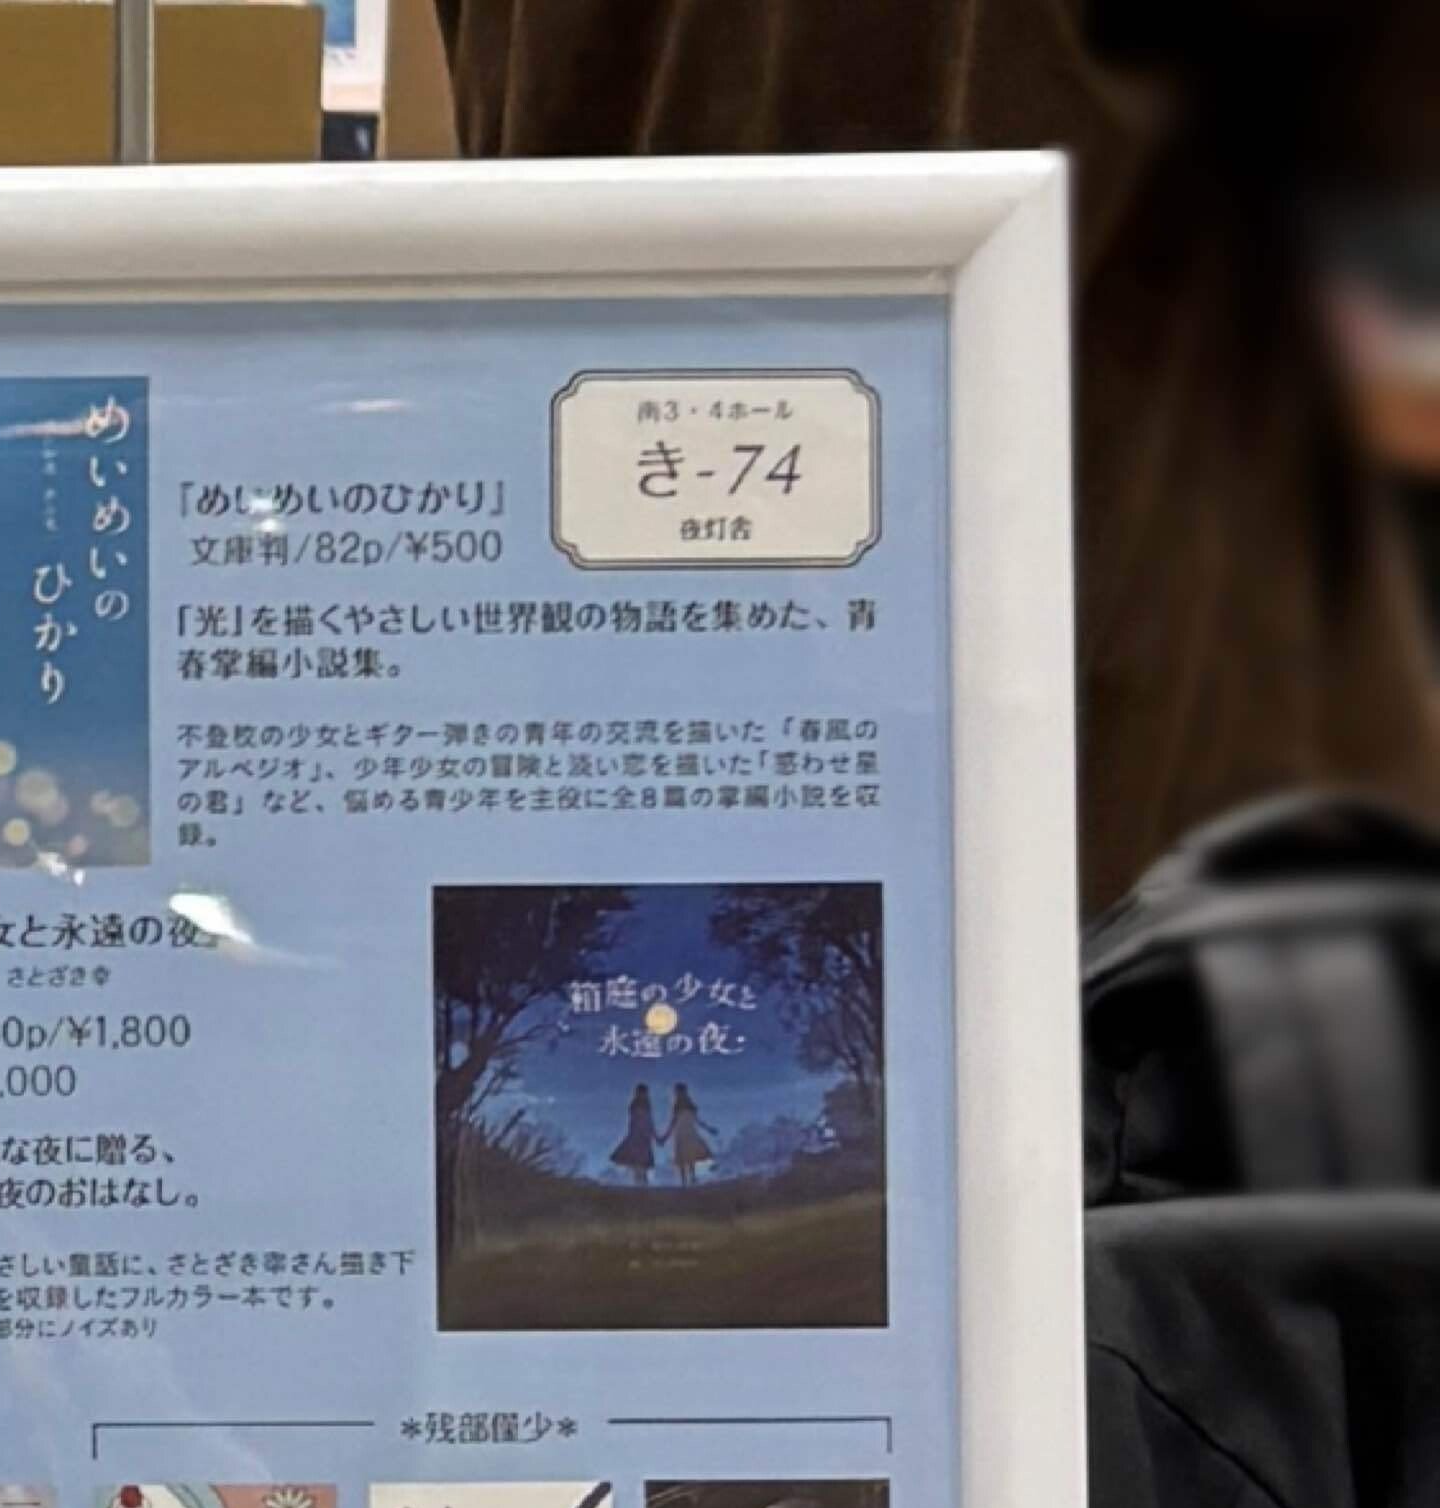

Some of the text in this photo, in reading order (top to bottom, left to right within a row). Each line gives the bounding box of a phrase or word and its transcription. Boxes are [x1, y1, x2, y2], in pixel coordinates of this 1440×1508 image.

[636, 439, 803, 499] き-74
[88, 395, 131, 622] めいめいの
[679, 515, 754, 542] 夜灯舎
[190, 528, 503, 567] 文庫判/82p/¥500
[33, 560, 79, 705] ひかり
[177, 598, 878, 637] 「光」を描くやさしい世界観の物語を集めた、青
[177, 646, 402, 680] 春掌編小説集。
[569, 972, 758, 1014] 箱庭の少女と
